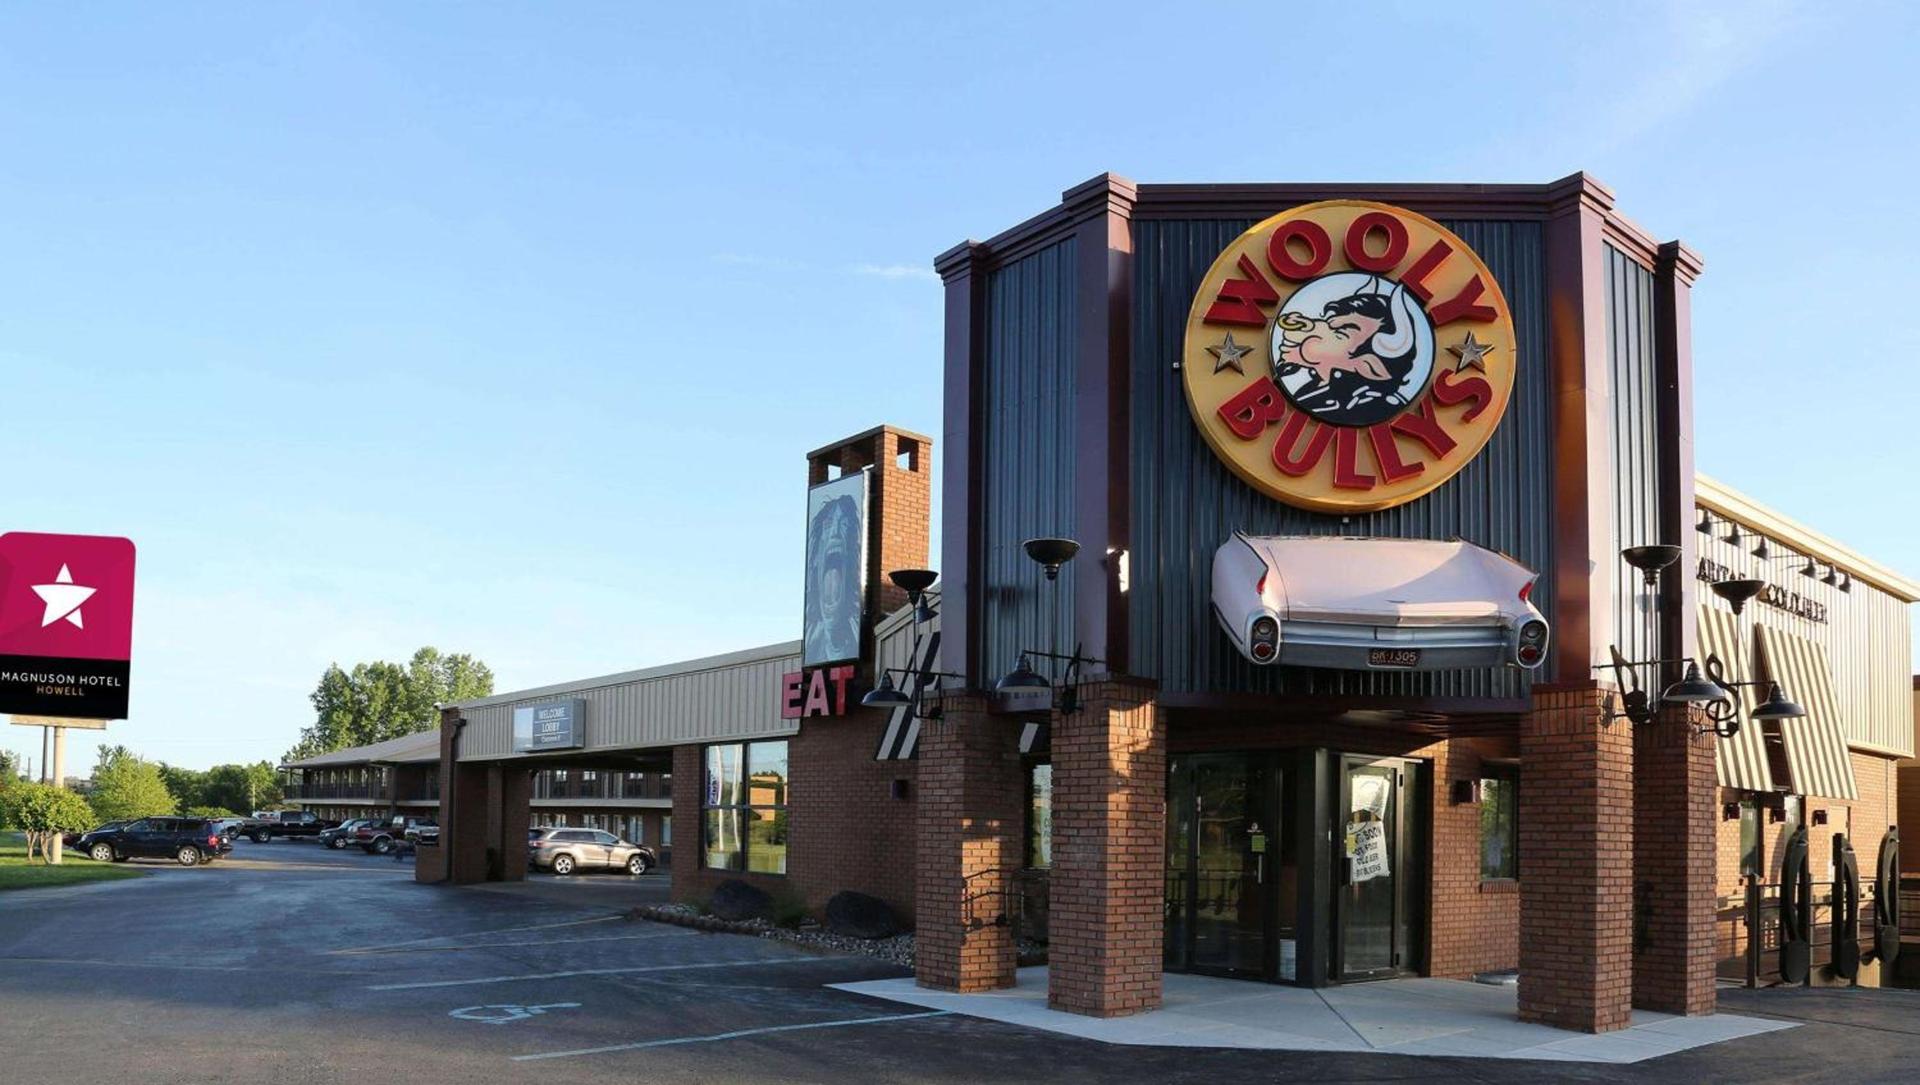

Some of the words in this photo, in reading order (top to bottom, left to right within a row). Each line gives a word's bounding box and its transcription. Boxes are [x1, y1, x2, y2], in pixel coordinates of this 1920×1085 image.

[1203, 211, 1498, 328] WOOLY
[1217, 367, 1493, 491] BULLYS
[1, 671, 75, 684] MAGNUSON
[79, 675, 121, 687] HOTEL
[36, 685, 85, 696] HOWELL
[781, 665, 854, 720] EAT
[538, 706, 565, 720] WELCOME
[542, 722, 560, 733] LOBBY
